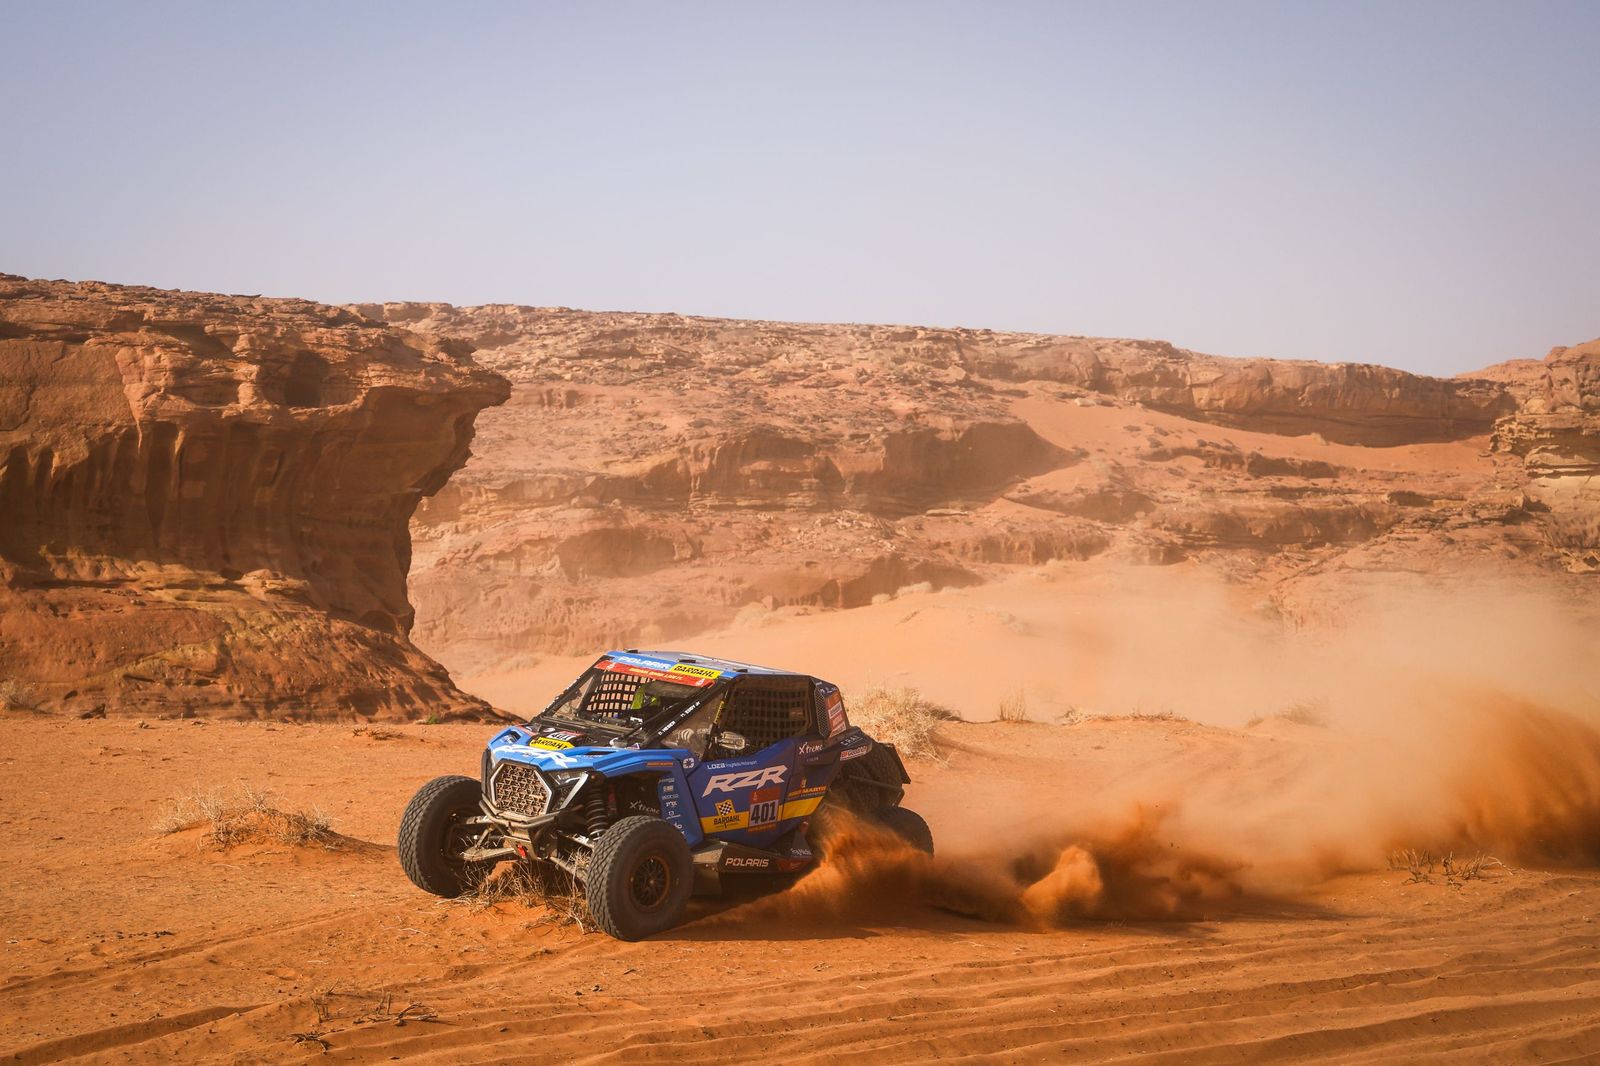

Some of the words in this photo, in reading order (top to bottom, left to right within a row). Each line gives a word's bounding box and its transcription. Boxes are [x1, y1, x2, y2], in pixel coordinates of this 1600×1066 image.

[674, 665, 714, 677] BARDAHL
[701, 765, 788, 798] RZR
[751, 801, 777, 824] 401
[713, 815, 740, 826] BARDAHL
[725, 857, 769, 868] POLARIS
